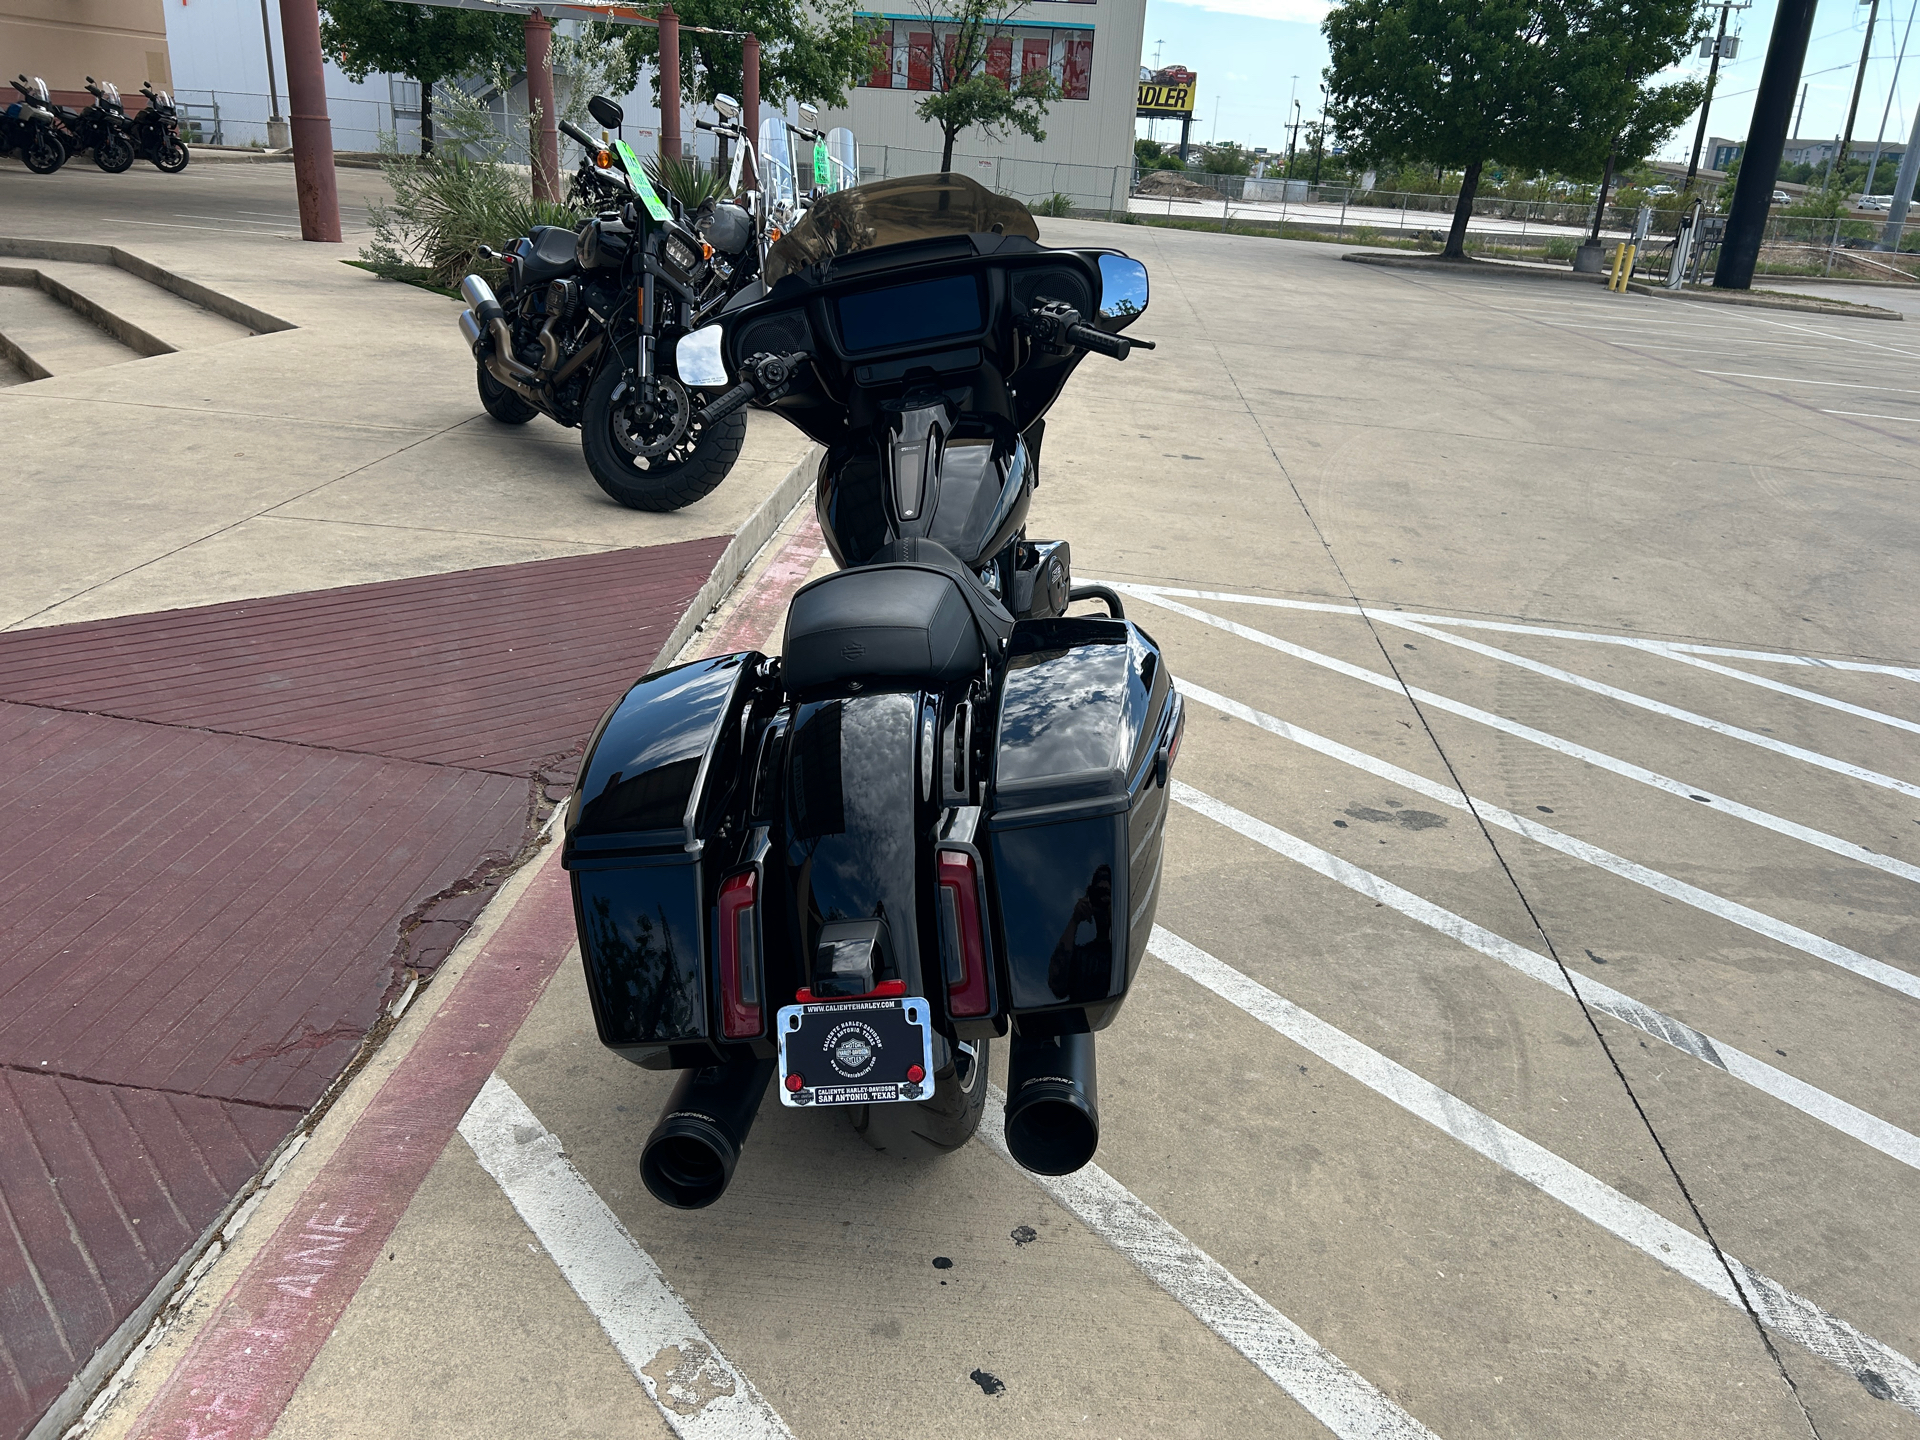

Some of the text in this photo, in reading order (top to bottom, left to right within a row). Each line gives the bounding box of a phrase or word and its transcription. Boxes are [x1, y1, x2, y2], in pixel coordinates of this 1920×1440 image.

[1137, 86, 1188, 108] ADLER
[808, 1001, 895, 1013] WWW.CALIENTEHARLEY.COM
[822, 1021, 883, 1052] CALIENTE HARLEY-DAVIDSON
[829, 1037, 838, 1048] SAN
[862, 1030, 876, 1046] TEXAS
[818, 1087, 845, 1096] CALIENTE
[846, 1085, 896, 1094] HARLEY-DAVIDSON
[818, 1095, 834, 1103] SAN
[835, 1093, 870, 1102] ANTONIO,
[871, 1091, 896, 1100] TEXAS
